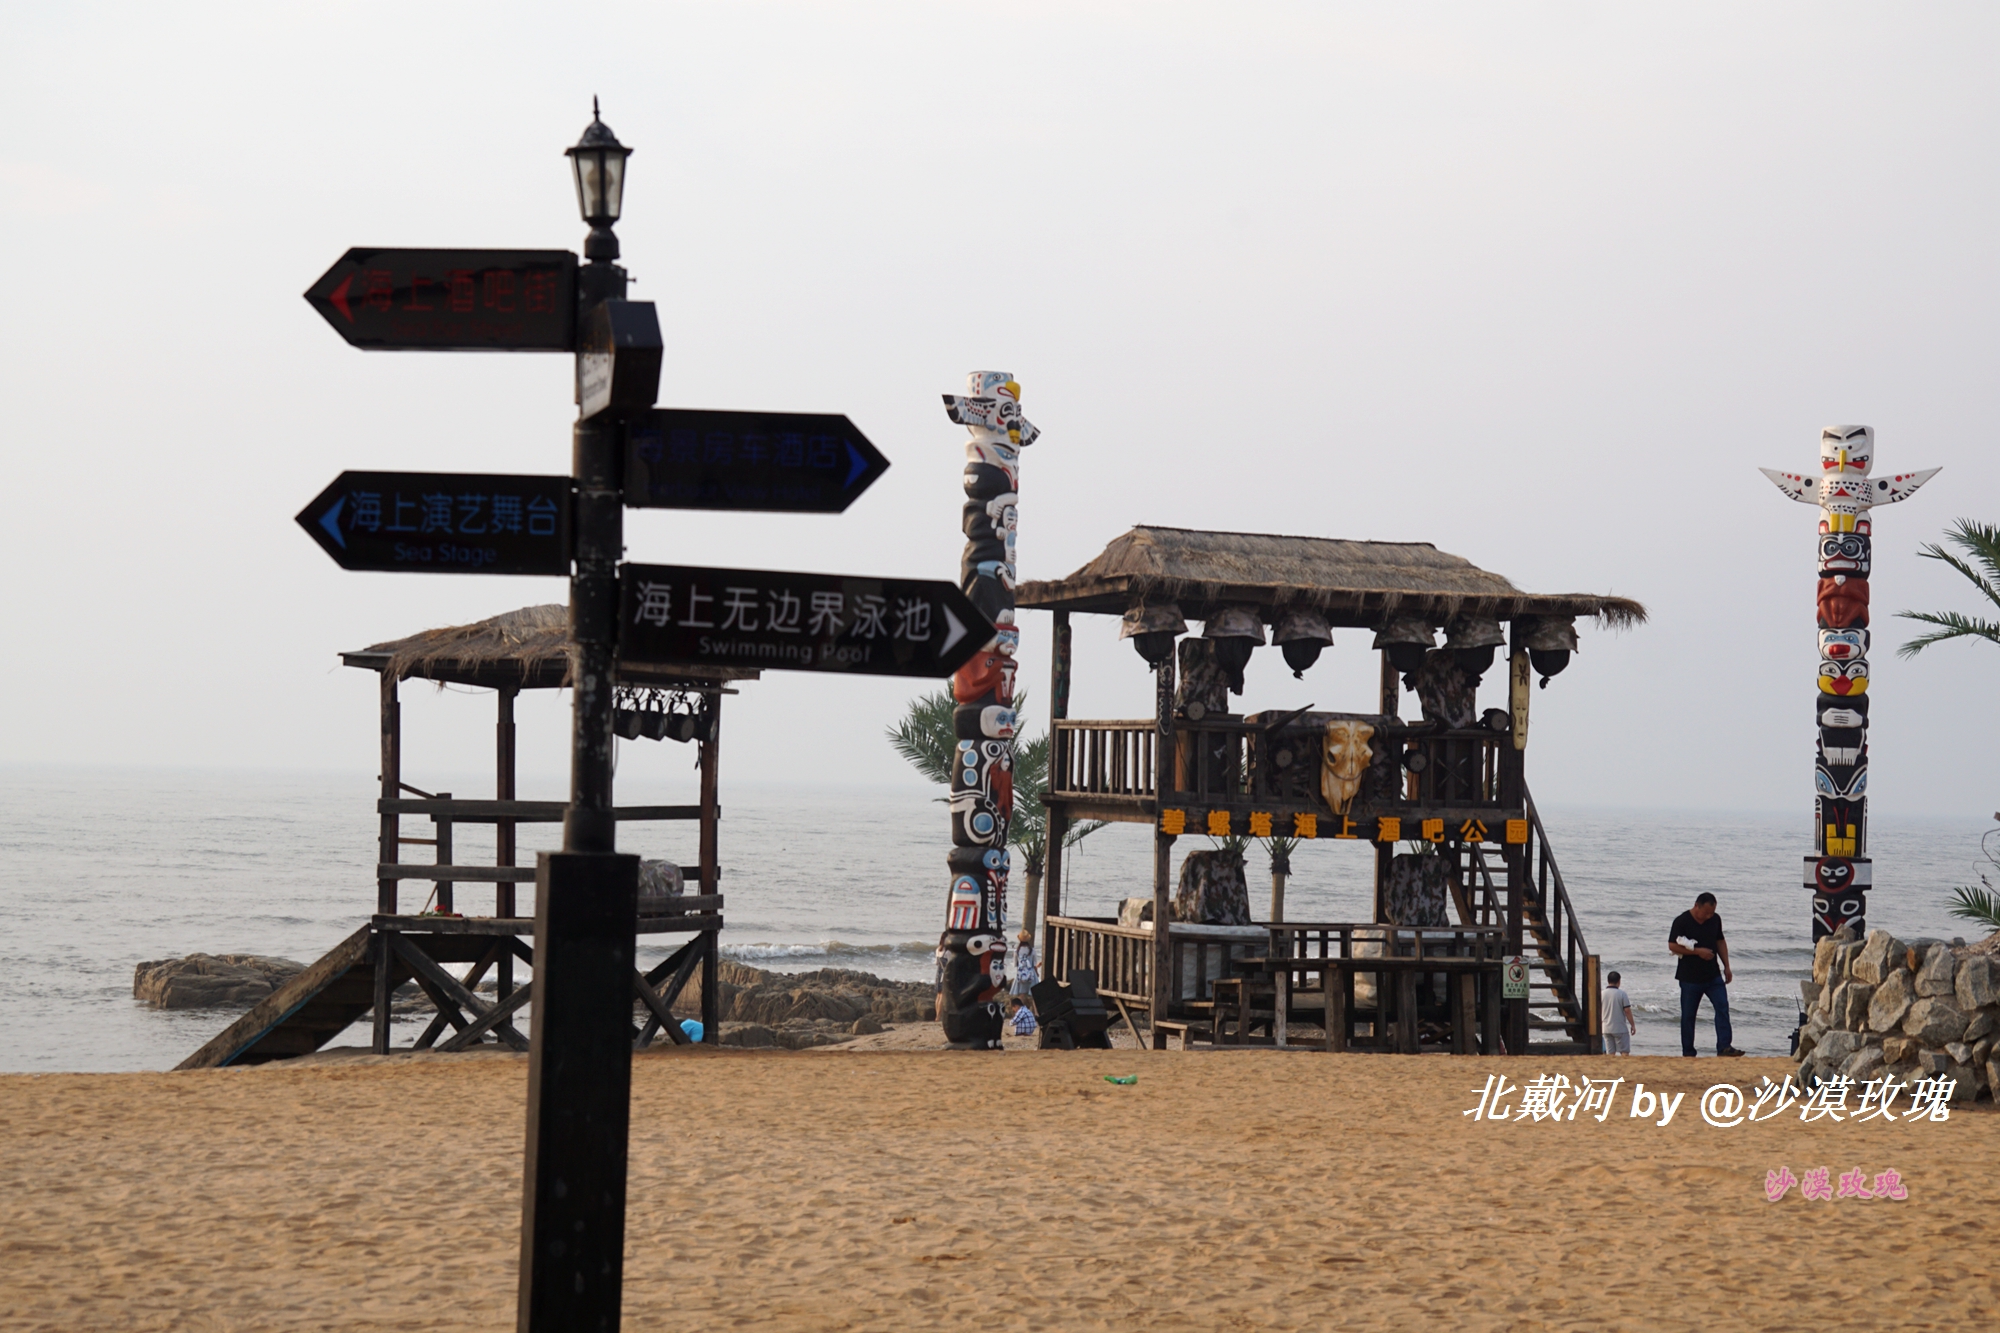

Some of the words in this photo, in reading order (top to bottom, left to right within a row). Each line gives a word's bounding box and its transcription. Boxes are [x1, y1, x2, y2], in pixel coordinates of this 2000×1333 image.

[359, 268, 557, 314] 海上酒吧街
[634, 429, 837, 469] 海景房车酒店
[349, 490, 559, 536] 海上演艺舞台
[394, 543, 431, 562] Sea
[438, 543, 497, 567] Stage
[634, 580, 931, 642] 海上无边界泳池
[699, 636, 812, 664] Swimming
[823, 645, 871, 663] Pool
[1162, 808, 1528, 844] 碧螺塔海上酒吧公园
